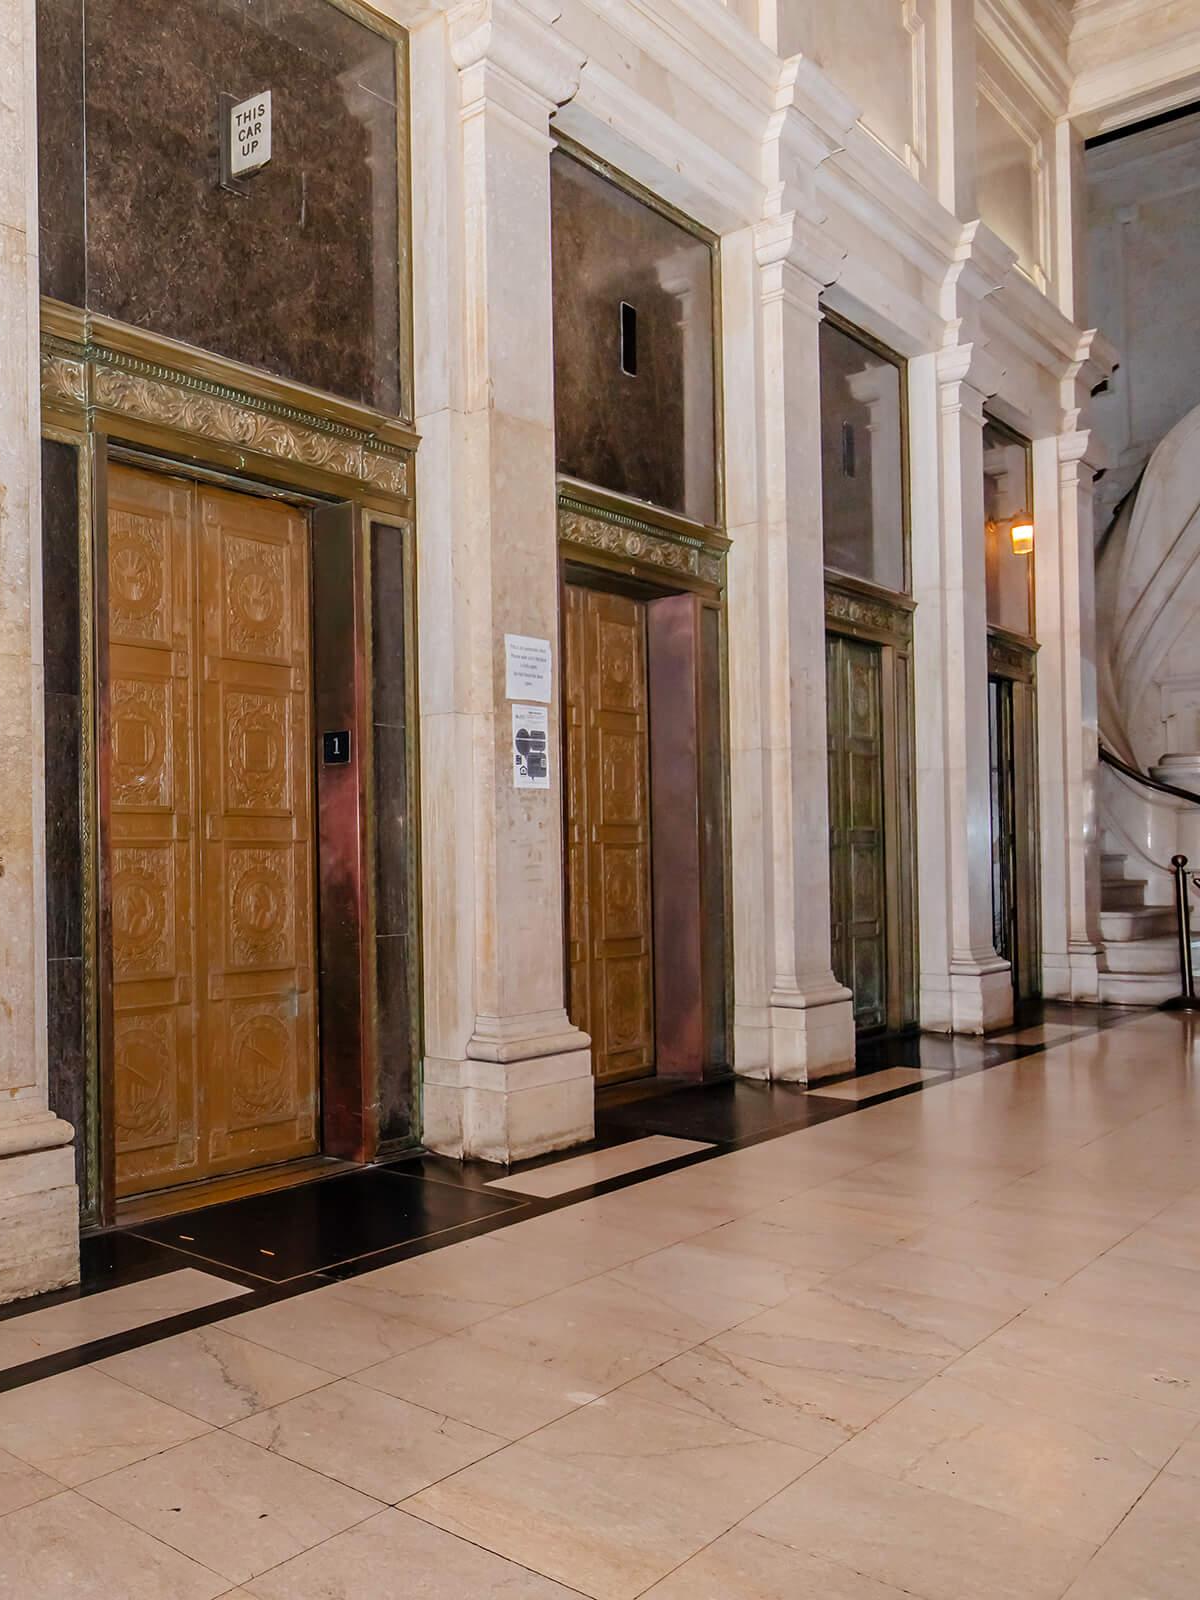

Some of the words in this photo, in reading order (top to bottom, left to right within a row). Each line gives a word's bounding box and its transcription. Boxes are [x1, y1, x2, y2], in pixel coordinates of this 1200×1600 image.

[235, 104, 265, 126] THIS
[238, 122, 262, 142] CAR
[242, 140, 259, 156] UP
[332, 736, 341, 755] 1
